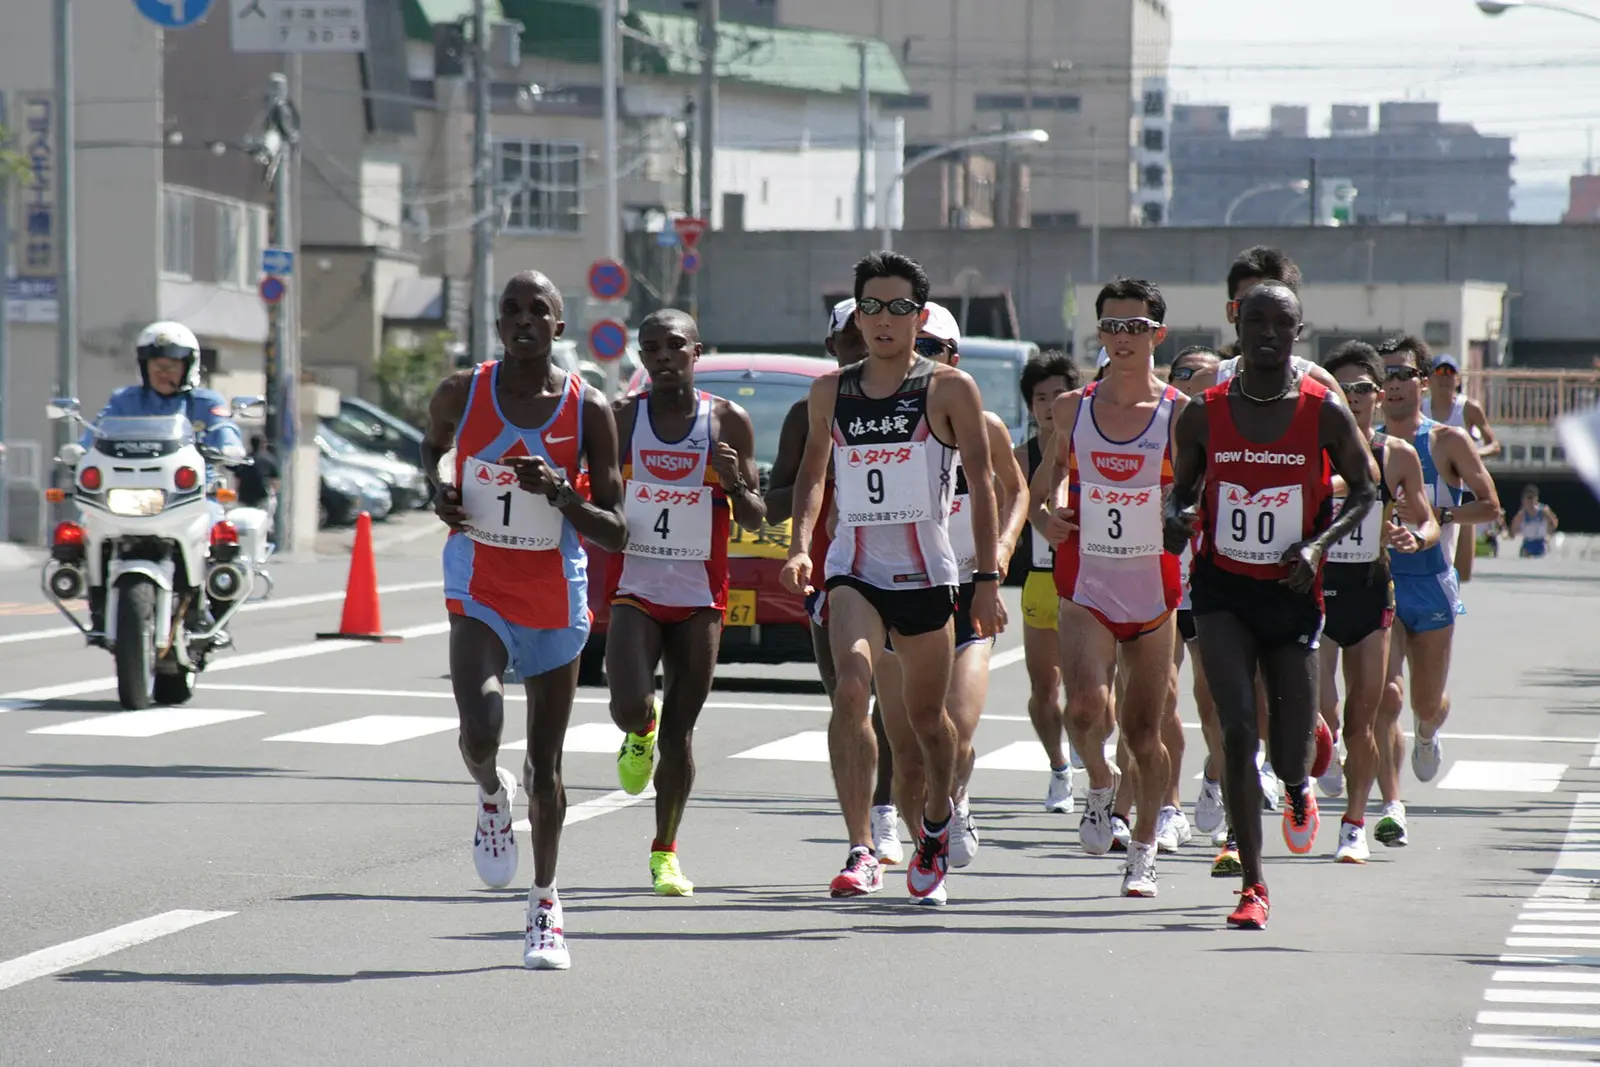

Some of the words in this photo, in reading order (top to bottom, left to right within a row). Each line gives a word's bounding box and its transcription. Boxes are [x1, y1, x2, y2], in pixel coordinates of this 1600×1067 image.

[848, 414, 910, 438] 佐久長聖
[645, 454, 693, 472] NISSIN
[864, 444, 913, 466] タケダ
[1096, 456, 1138, 472] NISSIN
[1215, 451, 1242, 464] new
[1244, 449, 1306, 466] balance
[867, 468, 885, 505] 9
[654, 488, 703, 505] タケダ
[1106, 489, 1151, 506] タケダ
[496, 491, 512, 527] 1
[847, 509, 924, 523] 2008北海道マラソン
[653, 508, 670, 539] 4
[1107, 508, 1122, 540] 3
[1231, 508, 1275, 544] 90
[469, 527, 554, 547] 2008北海道マラソン
[629, 542, 704, 557] 2008北海道マラソン
[1087, 542, 1157, 556] 2008北海道マラソン
[1223, 546, 1282, 561] 2008北海道マラ
